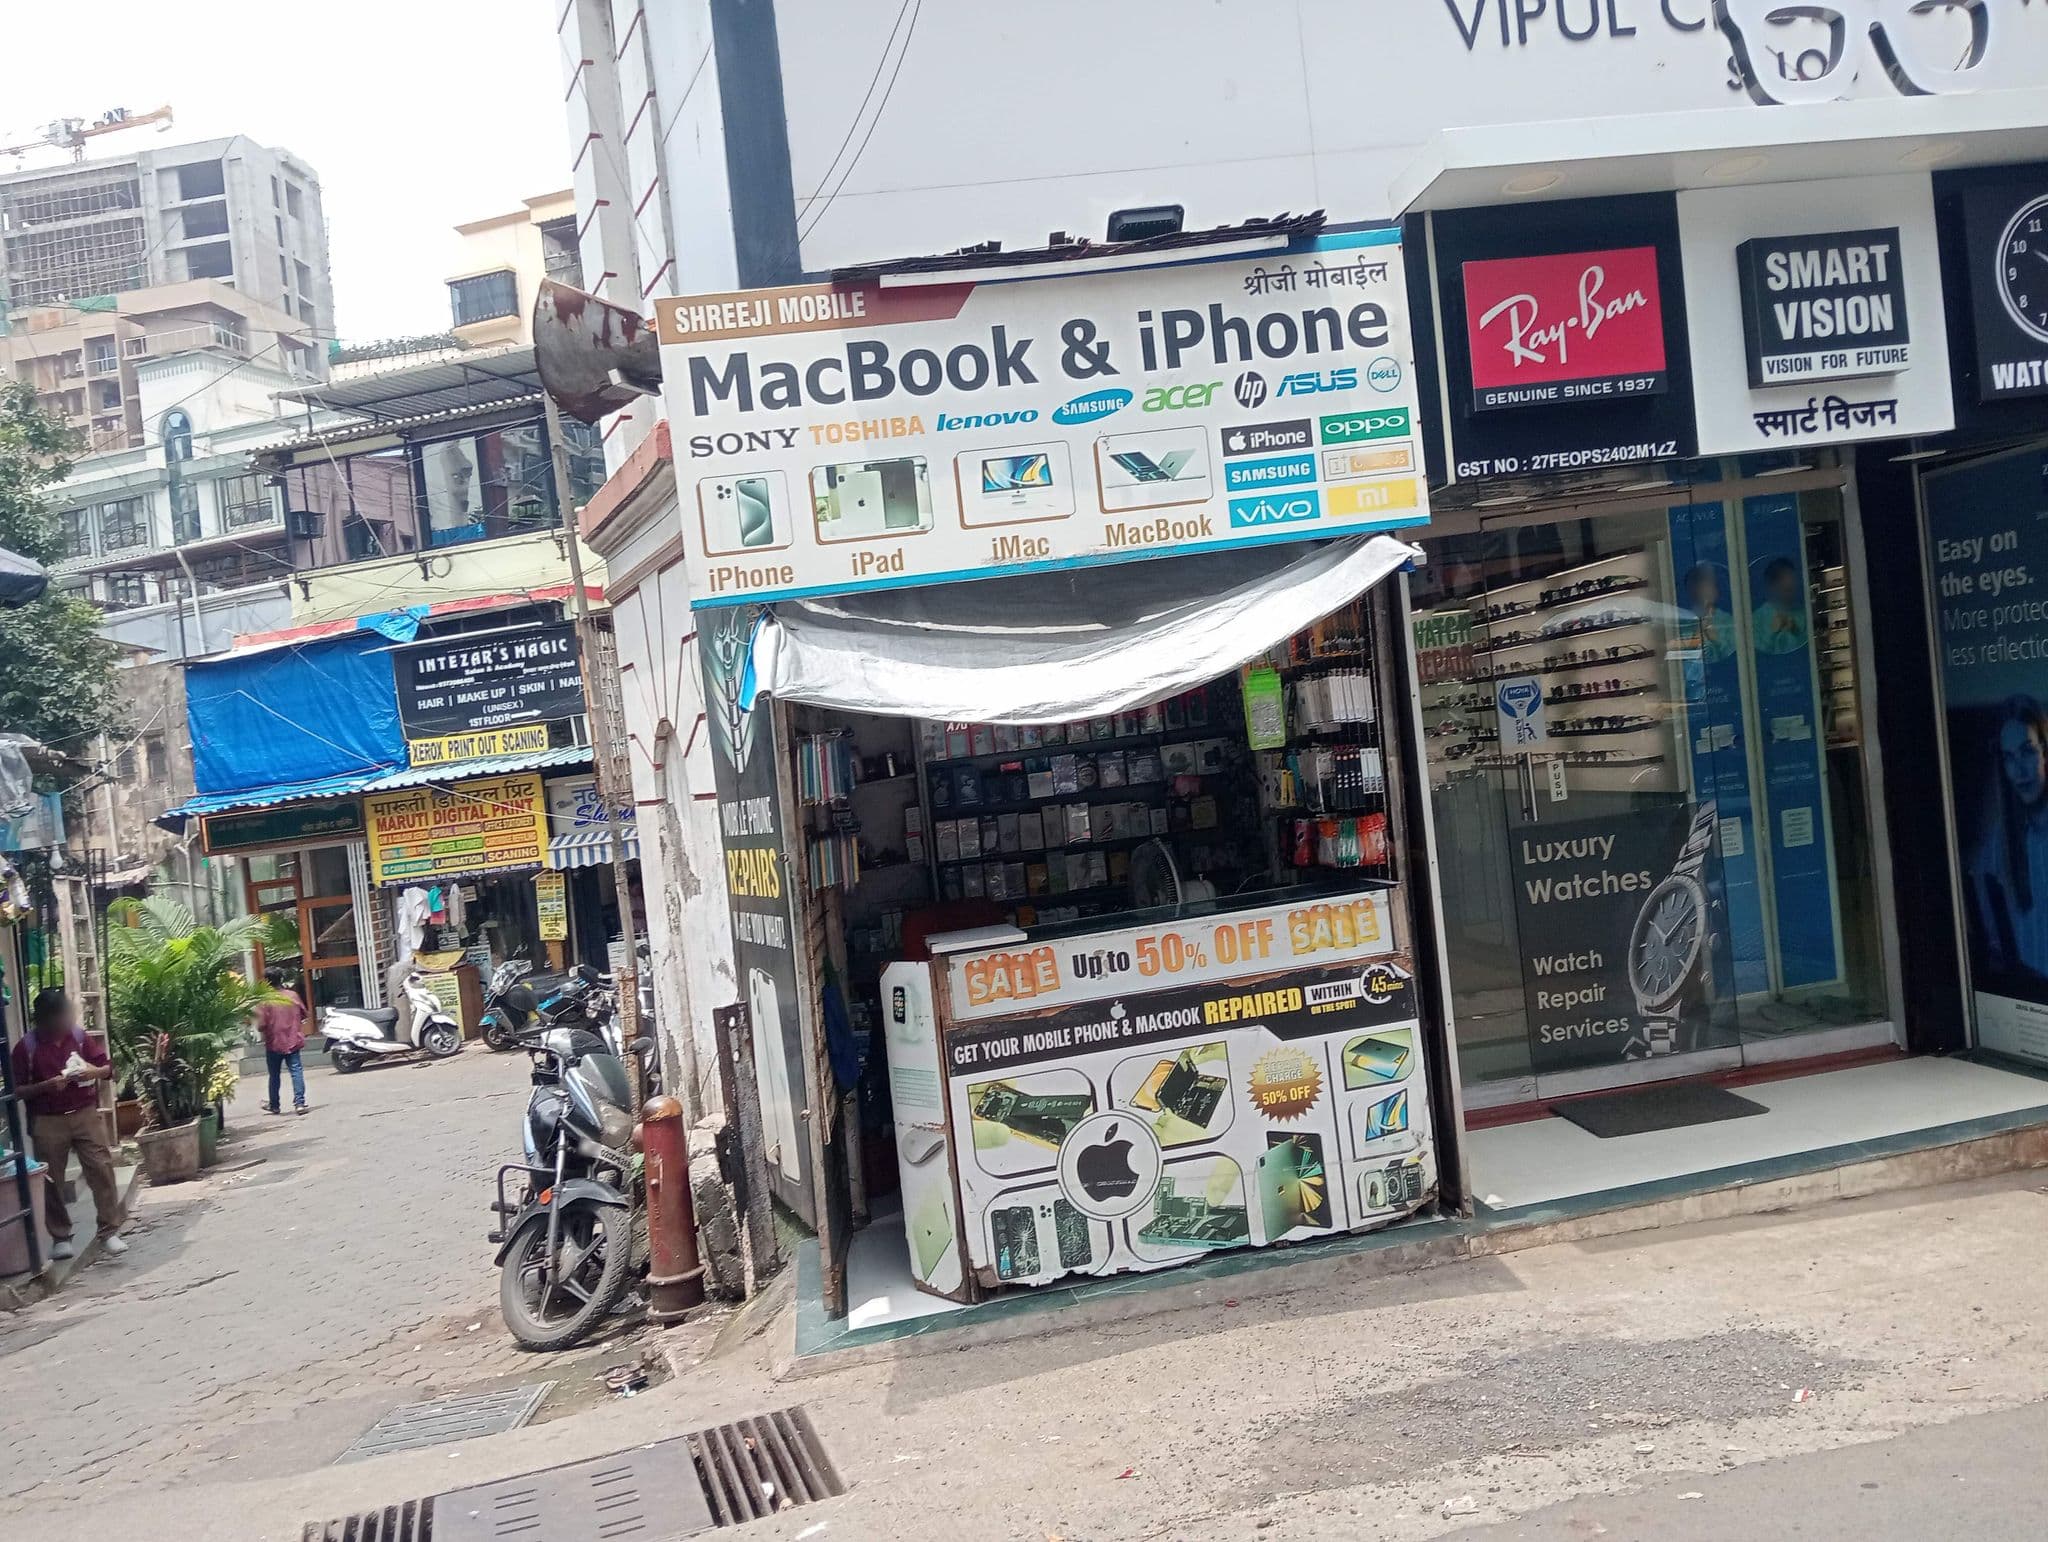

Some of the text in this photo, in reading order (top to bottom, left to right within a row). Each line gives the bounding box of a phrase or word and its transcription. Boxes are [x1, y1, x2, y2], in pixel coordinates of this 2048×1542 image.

[1443, 0, 1637, 51] VIPUL
[2029, 219, 2042, 232] 11
[2013, 240, 2027, 254] 10
[1243, 254, 1388, 296] श्रीजी मोबाईल
[1766, 244, 1889, 291] SMART
[2008, 267, 2018, 281] 9
[674, 291, 867, 334] SHREEJI MOBILE
[2019, 295, 2028, 308] 8
[1774, 294, 1894, 340] VISION
[688, 301, 1390, 417] MacBook & iPhone
[1766, 348, 1909, 375] VISION FOR FUTURE
[1992, 360, 2048, 390] WAT
[1485, 377, 1656, 406] GENUINE SINCE 1937
[689, 367, 1398, 458] SONY TOSHIBA lenovo SAMSUNG acer hp ASUS DELL
[1753, 395, 1899, 437] स्मार्ट विजन
[1250, 430, 1307, 449] iPhone
[1230, 462, 1311, 484] SAMSUNG
[1457, 460, 1490, 477] GST
[1494, 458, 1519, 473] NO
[1236, 498, 1313, 523] vivo
[1104, 514, 1214, 548] MacBook
[850, 547, 905, 577] iPad
[991, 535, 1051, 562] iMac
[1937, 530, 2018, 564] Easy on
[709, 562, 795, 592] iPhone
[1940, 565, 2035, 598] the eyes.
[1943, 607, 1988, 632] More
[418, 645, 509, 674] INTEZAR'S
[515, 638, 568, 659] MAGIC
[417, 697, 445, 711] HAIR
[457, 689, 490, 705] MAKE
[491, 687, 506, 699] UP
[518, 681, 546, 696] SKIN
[483, 713, 512, 727] FLOOR
[412, 729, 545, 763] XEROX PRINT OUT SCANING
[1552, 763, 1565, 798] PUSH
[376, 811, 430, 833] MARUTI
[433, 804, 488, 825] DIGITAL
[491, 797, 534, 818] PRINT
[1522, 834, 1616, 866] Luxury
[726, 847, 781, 900] REPAIRS
[1525, 870, 1652, 905] Watches
[971, 960, 1056, 1001] SALE
[1135, 933, 1205, 977] 50%
[1213, 919, 1274, 964] OFF
[1291, 910, 1377, 950] SALE
[1532, 949, 1603, 976] Watch
[1537, 983, 1607, 1011] Repair
[953, 1044, 979, 1066] GET
[983, 1038, 1021, 1060] YOUR
[1023, 1028, 1072, 1053] MOBILE
[1074, 1020, 1118, 1045] PHONE
[1121, 1019, 1133, 1037] &
[1135, 1006, 1201, 1035] MACBOOK
[1204, 986, 1303, 1025] REPAIRED
[1310, 982, 1353, 1001] WITHIN
[1371, 975, 1387, 994] 45
[1539, 1016, 1630, 1044] Services
[1261, 1085, 1311, 1106] 50% OFF
